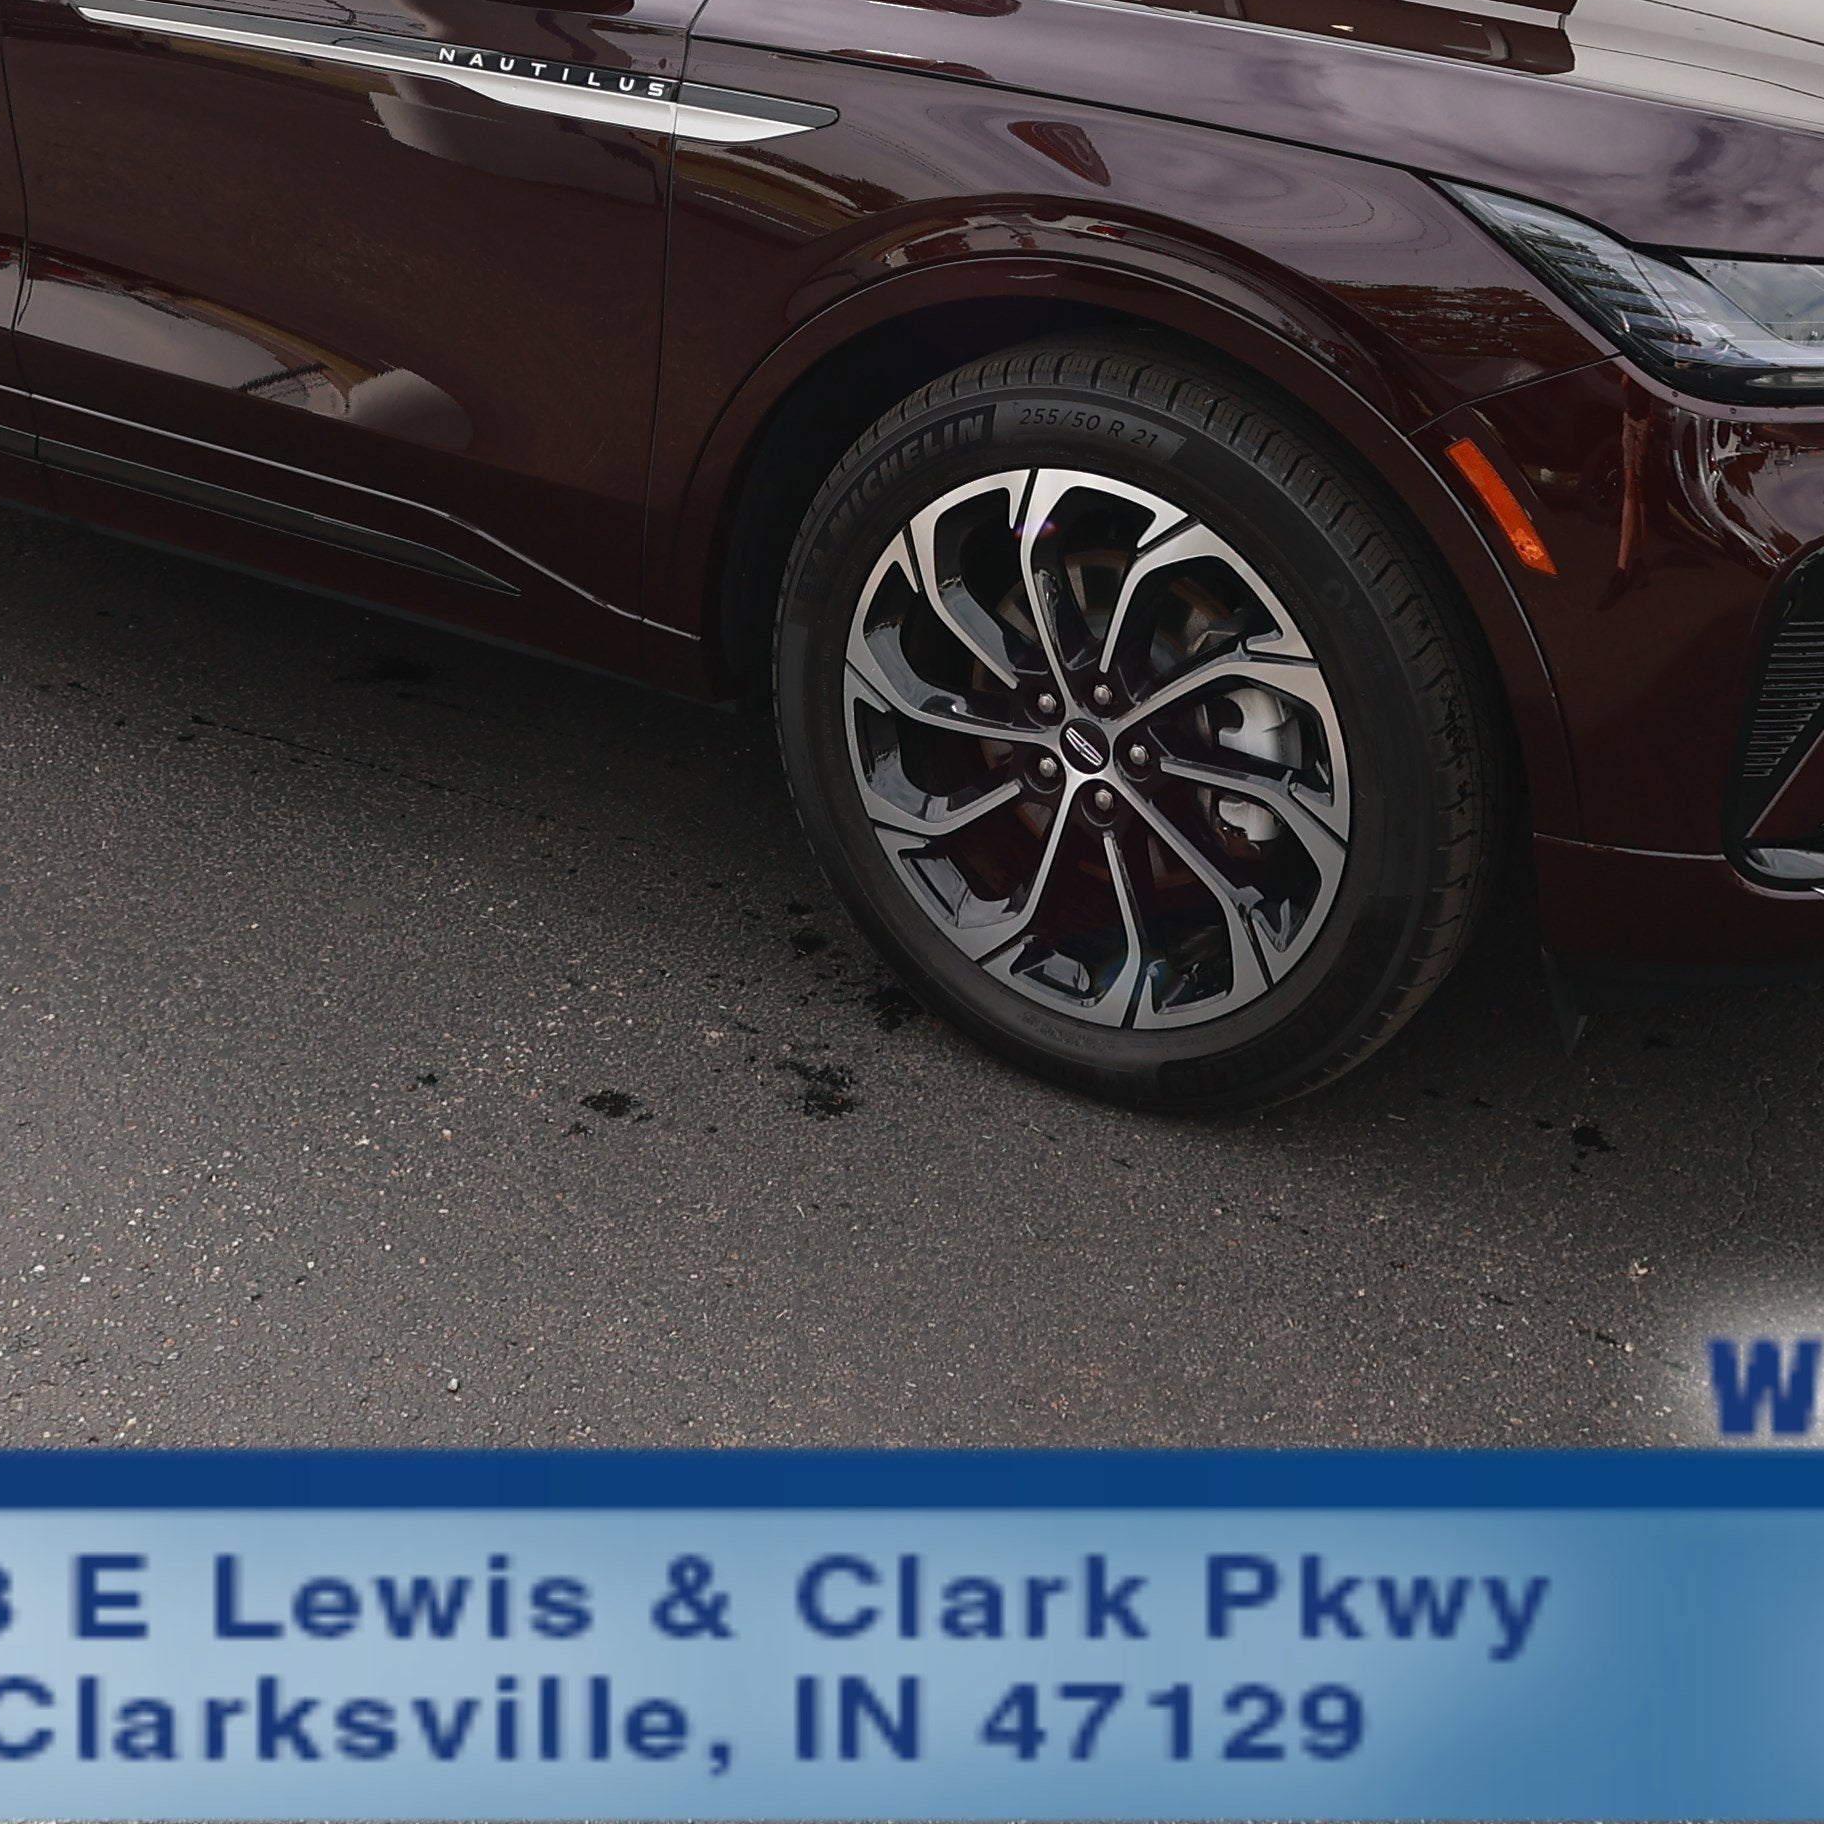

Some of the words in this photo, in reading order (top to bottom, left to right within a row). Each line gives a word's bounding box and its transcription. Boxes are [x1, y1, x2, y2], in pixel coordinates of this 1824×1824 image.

[438, 47, 665, 97] NAUTILUS
[1018, 407, 1101, 432] 255/50
[1107, 418, 1126, 440] R
[1130, 430, 1159, 450] 21
[828, 412, 985, 542] MICHELIN
